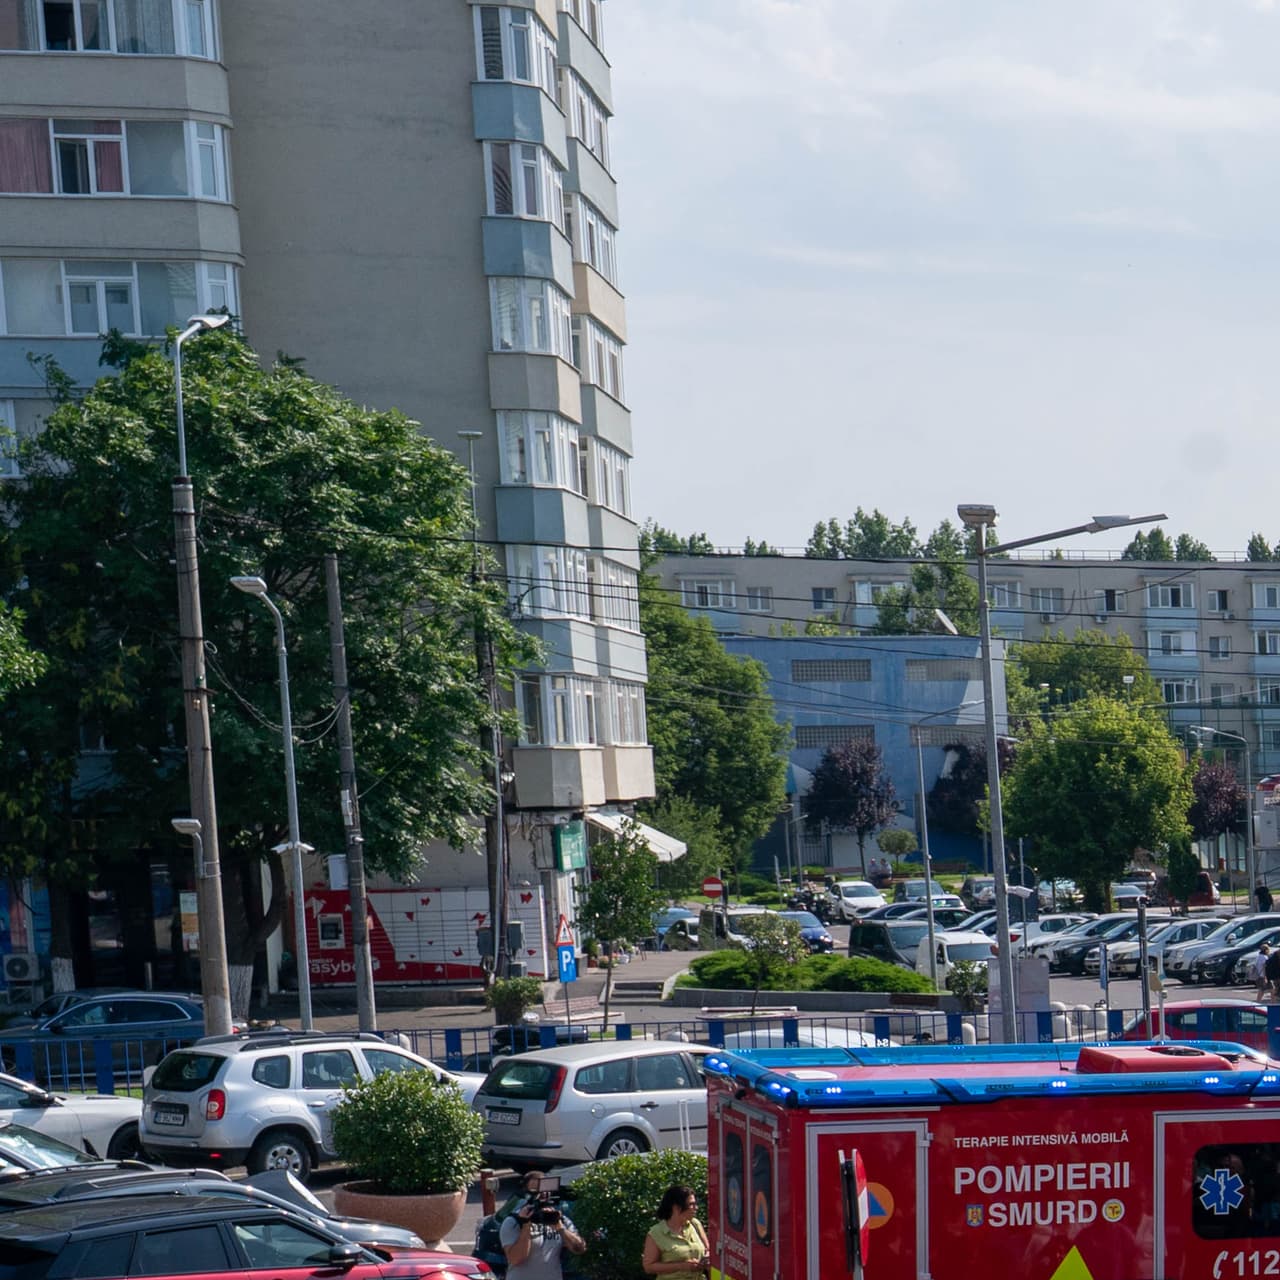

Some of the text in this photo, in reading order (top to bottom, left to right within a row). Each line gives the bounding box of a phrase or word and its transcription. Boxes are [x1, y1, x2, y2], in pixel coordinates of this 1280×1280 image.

[954, 1129, 1129, 1148] TERAPIE INTENSIVĂ MOBILĂ
[954, 1161, 1130, 1195] POMPIERII
[988, 1200, 1097, 1227] SMURD
[1233, 1250, 1280, 1276] 112
